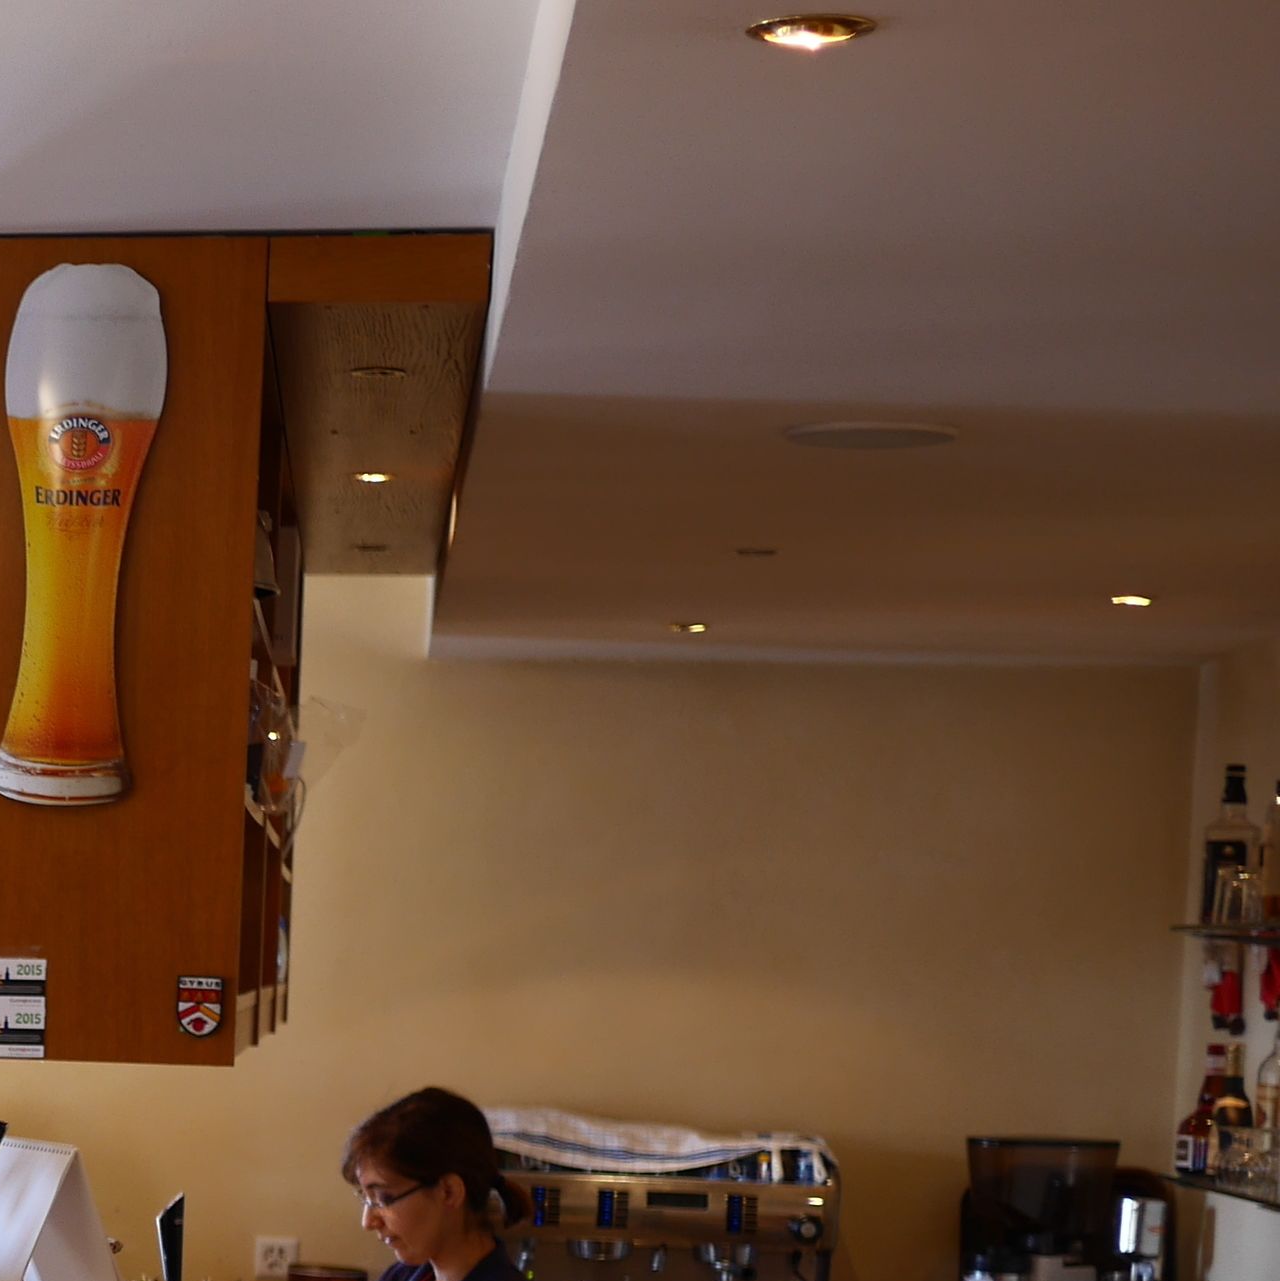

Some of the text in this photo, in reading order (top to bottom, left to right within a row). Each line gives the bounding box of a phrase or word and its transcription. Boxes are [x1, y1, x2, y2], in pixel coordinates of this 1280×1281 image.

[49, 417, 109, 441] ERDINGER
[35, 486, 121, 507] ERDINGER
[17, 964, 43, 976] 2015
[15, 1013, 41, 1025] 2015
